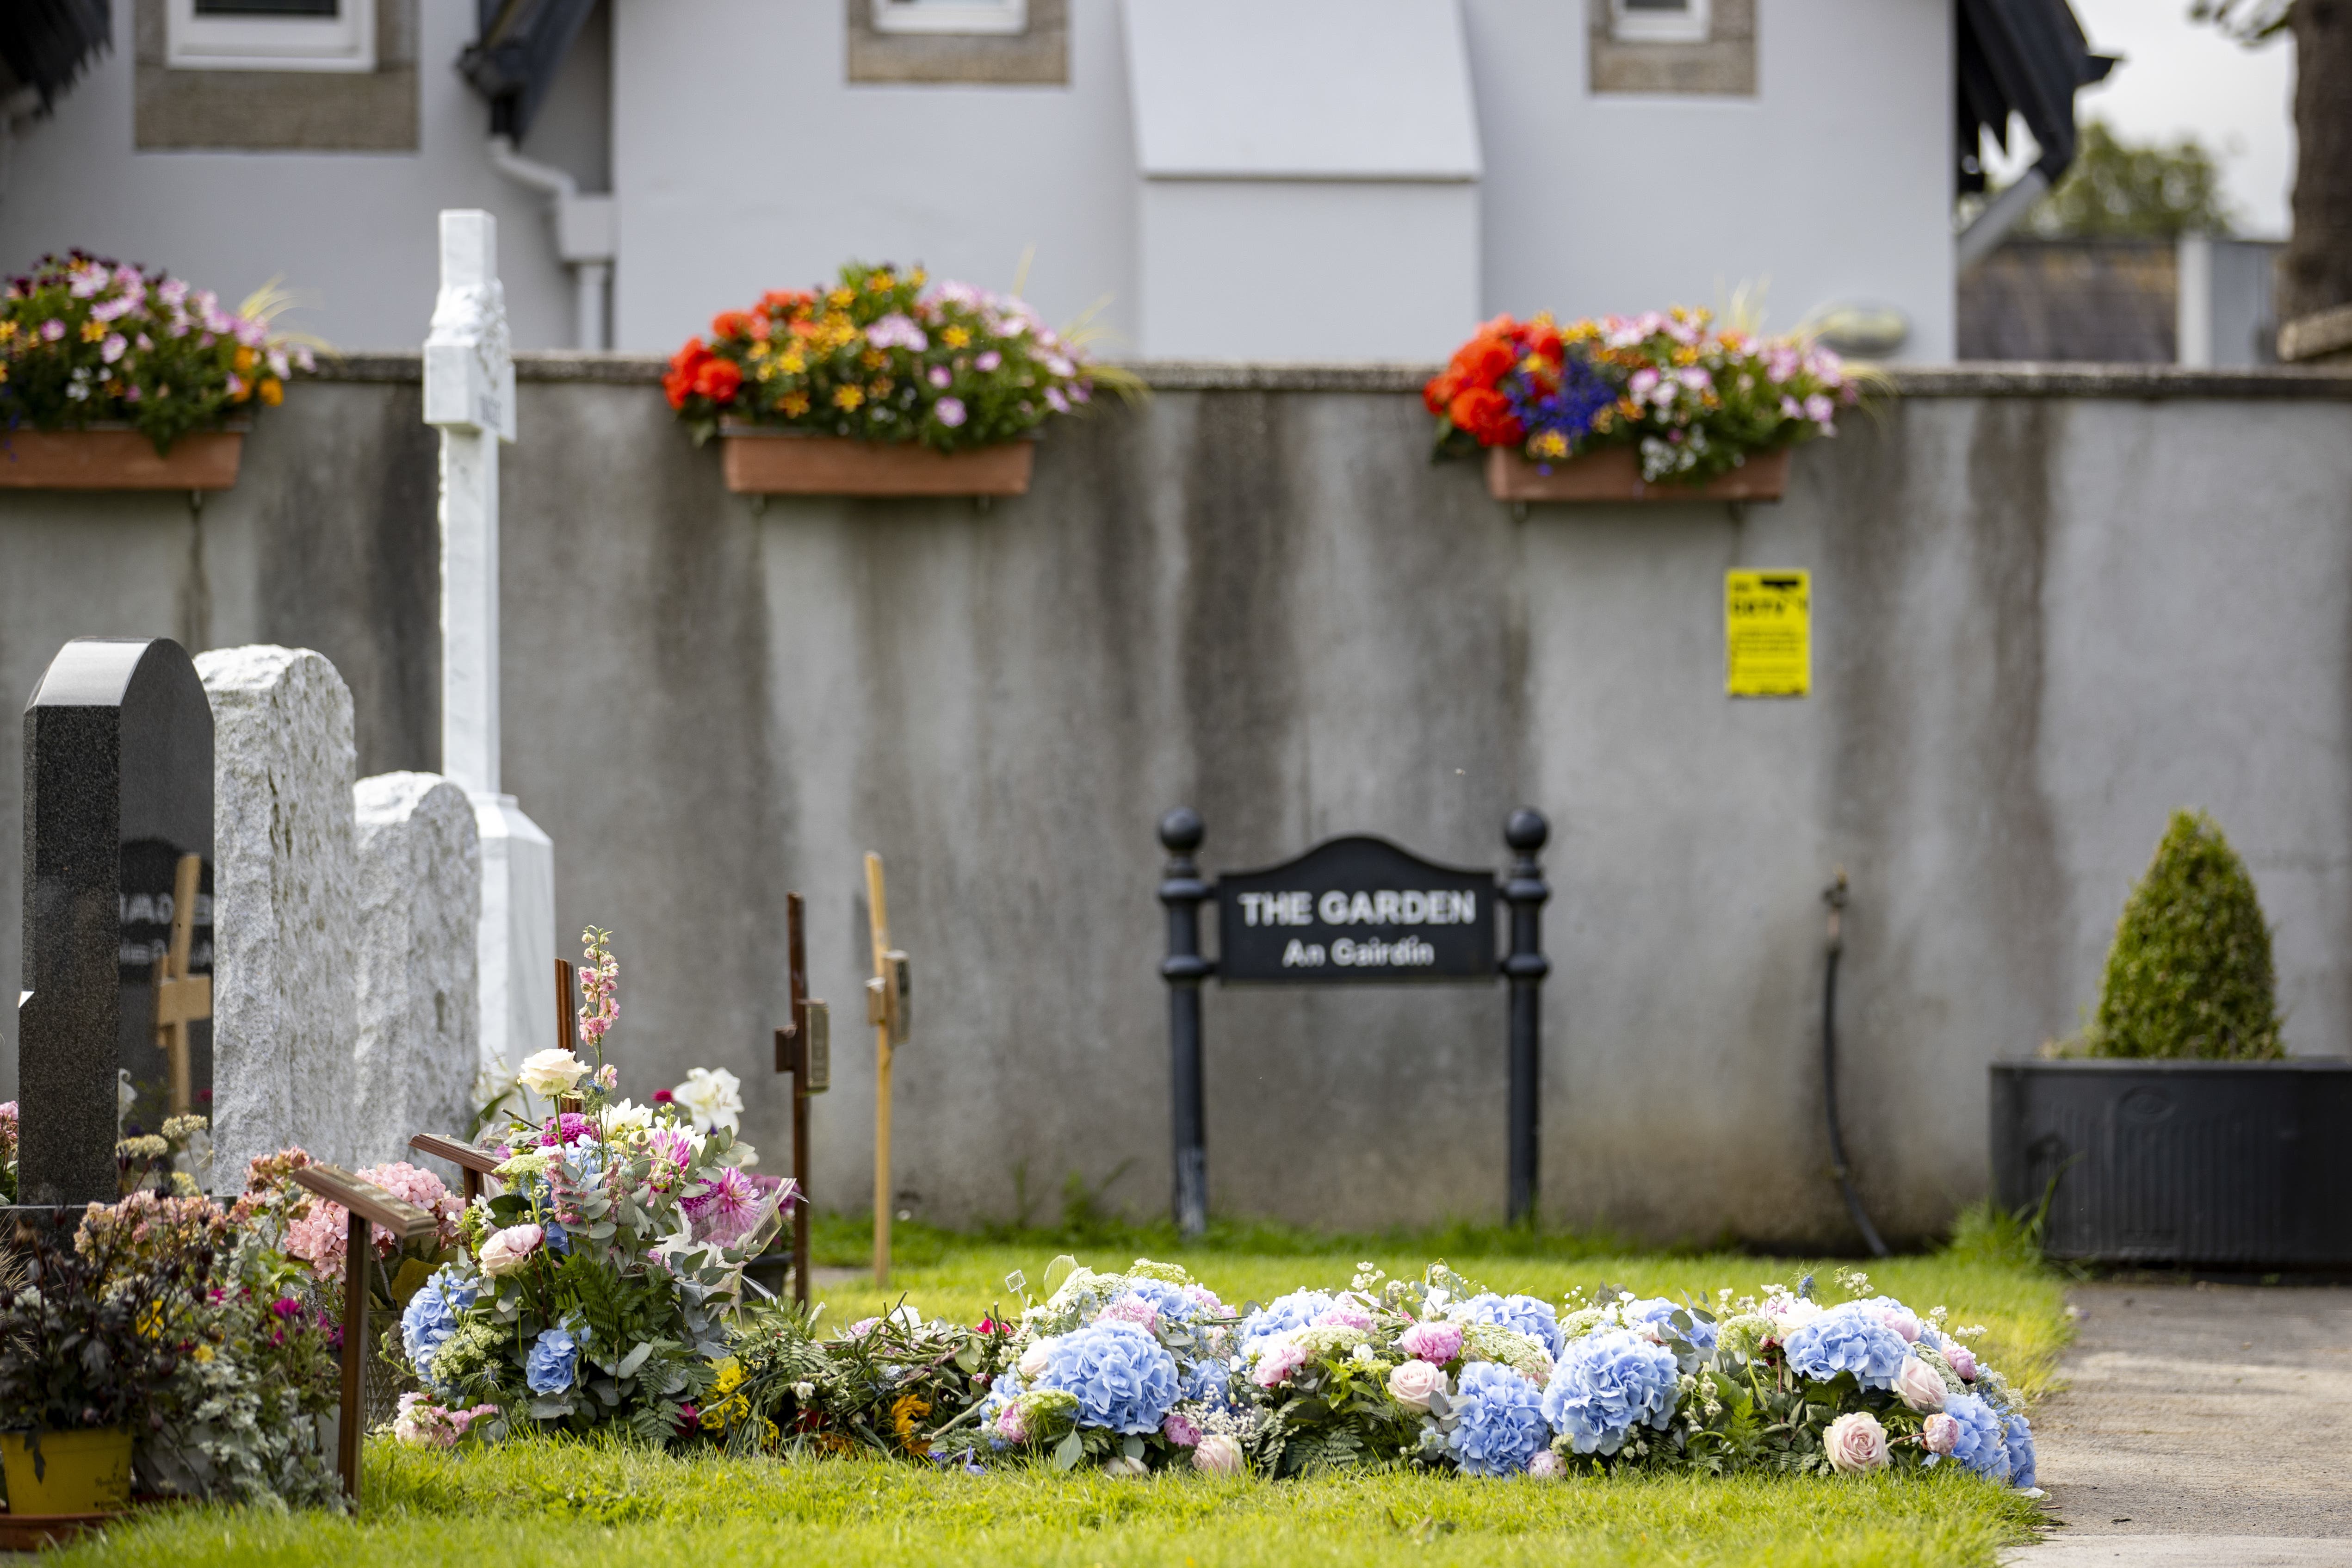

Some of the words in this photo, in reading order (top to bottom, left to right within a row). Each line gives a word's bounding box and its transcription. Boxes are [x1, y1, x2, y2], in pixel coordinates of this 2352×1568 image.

[1238, 892, 1313, 926] THE
[1318, 890, 1476, 924] GARDEN
[1282, 939, 1325, 967] An
[1331, 935, 1435, 967] Gairdín
